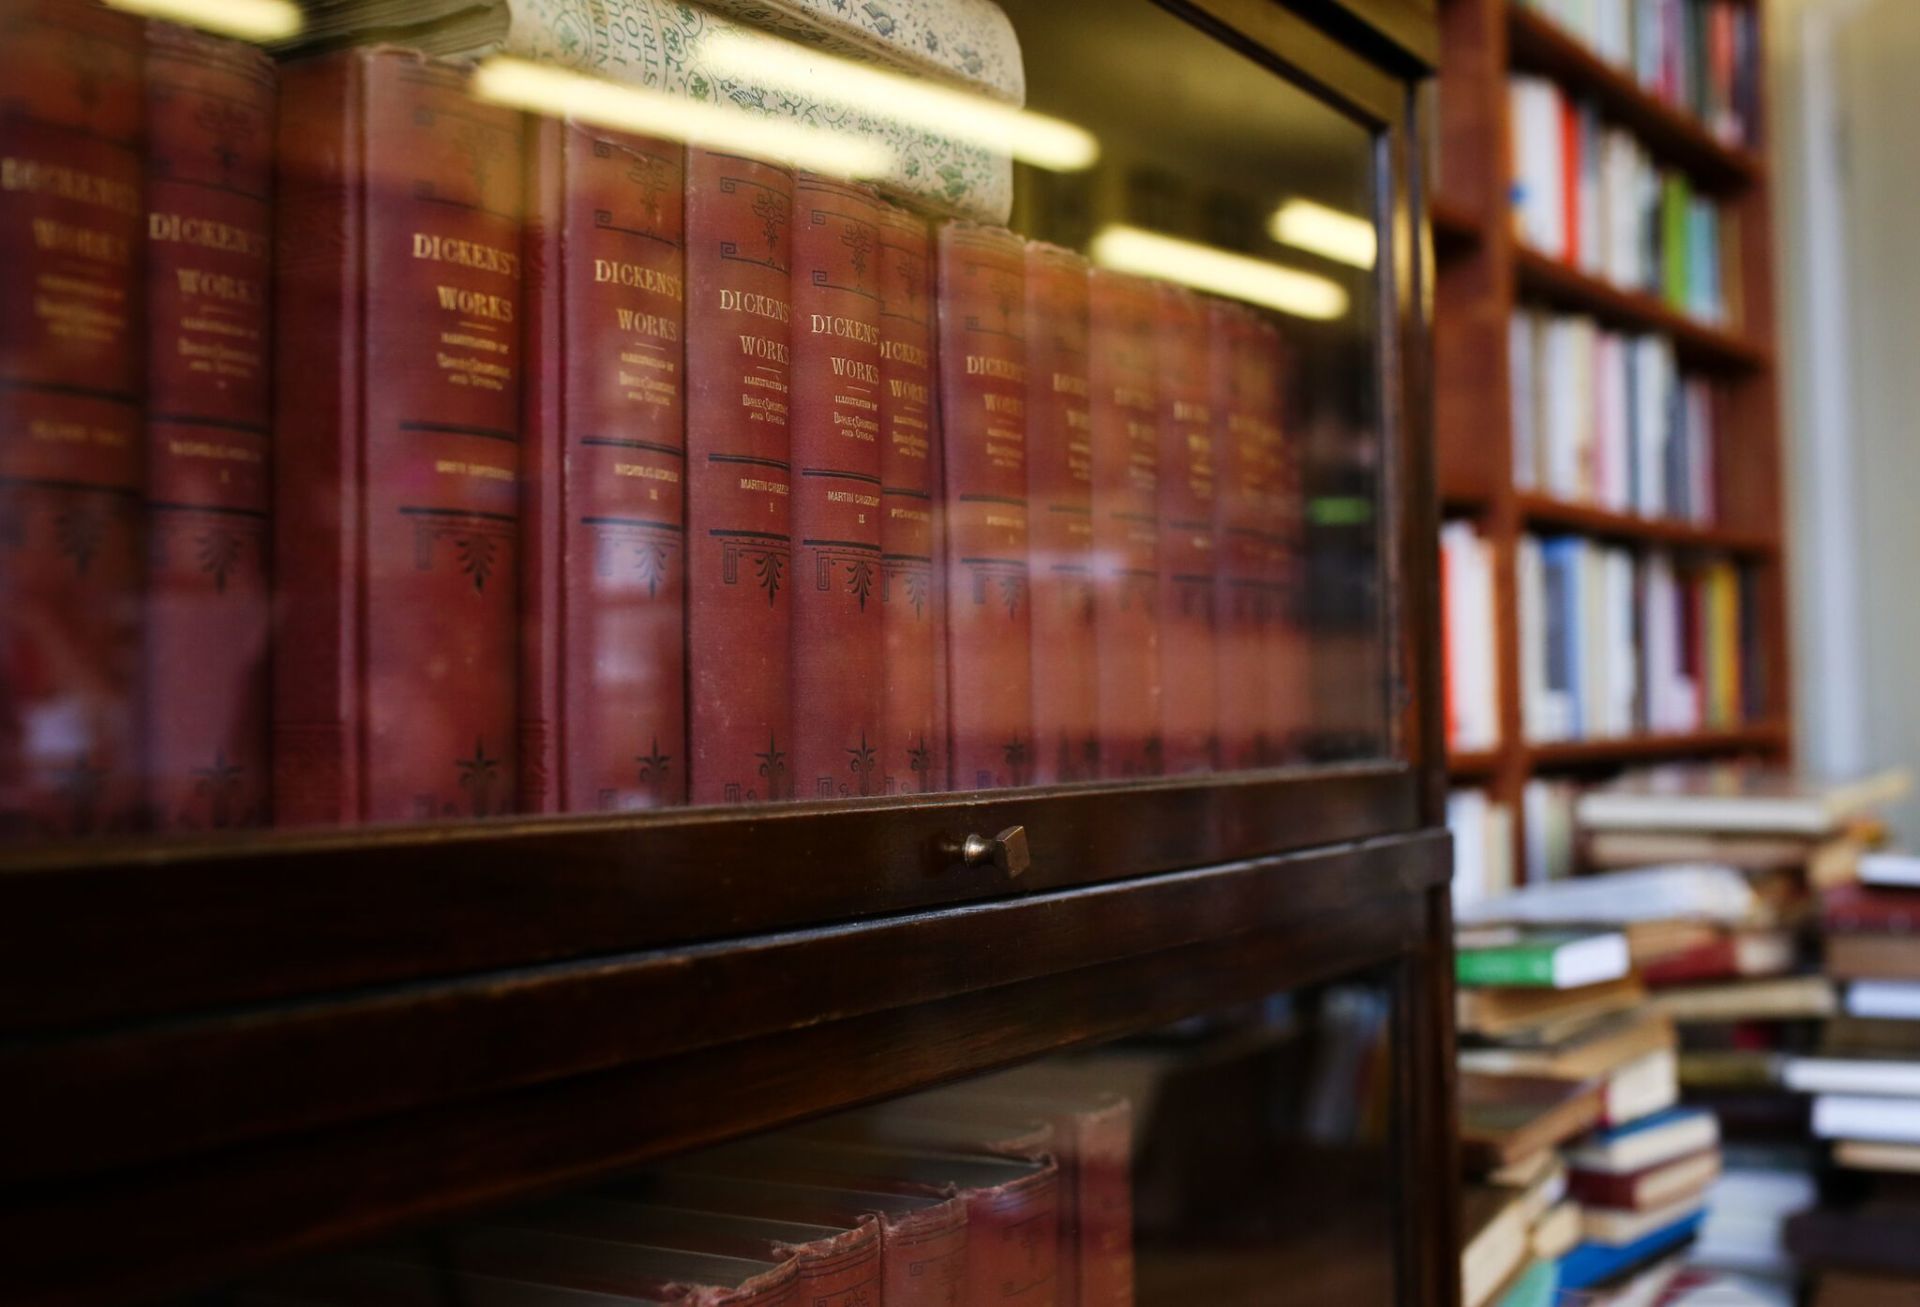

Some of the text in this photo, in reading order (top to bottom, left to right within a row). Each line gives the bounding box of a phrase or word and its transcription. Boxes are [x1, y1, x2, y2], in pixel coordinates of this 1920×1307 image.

[436, 286, 514, 322] WORKS
[617, 308, 678, 342] WORKS
[739, 335, 790, 365] WORKS
[831, 357, 880, 385] WORKS
[740, 478, 767, 492] MARTIN
[826, 490, 854, 503] MARTIN
